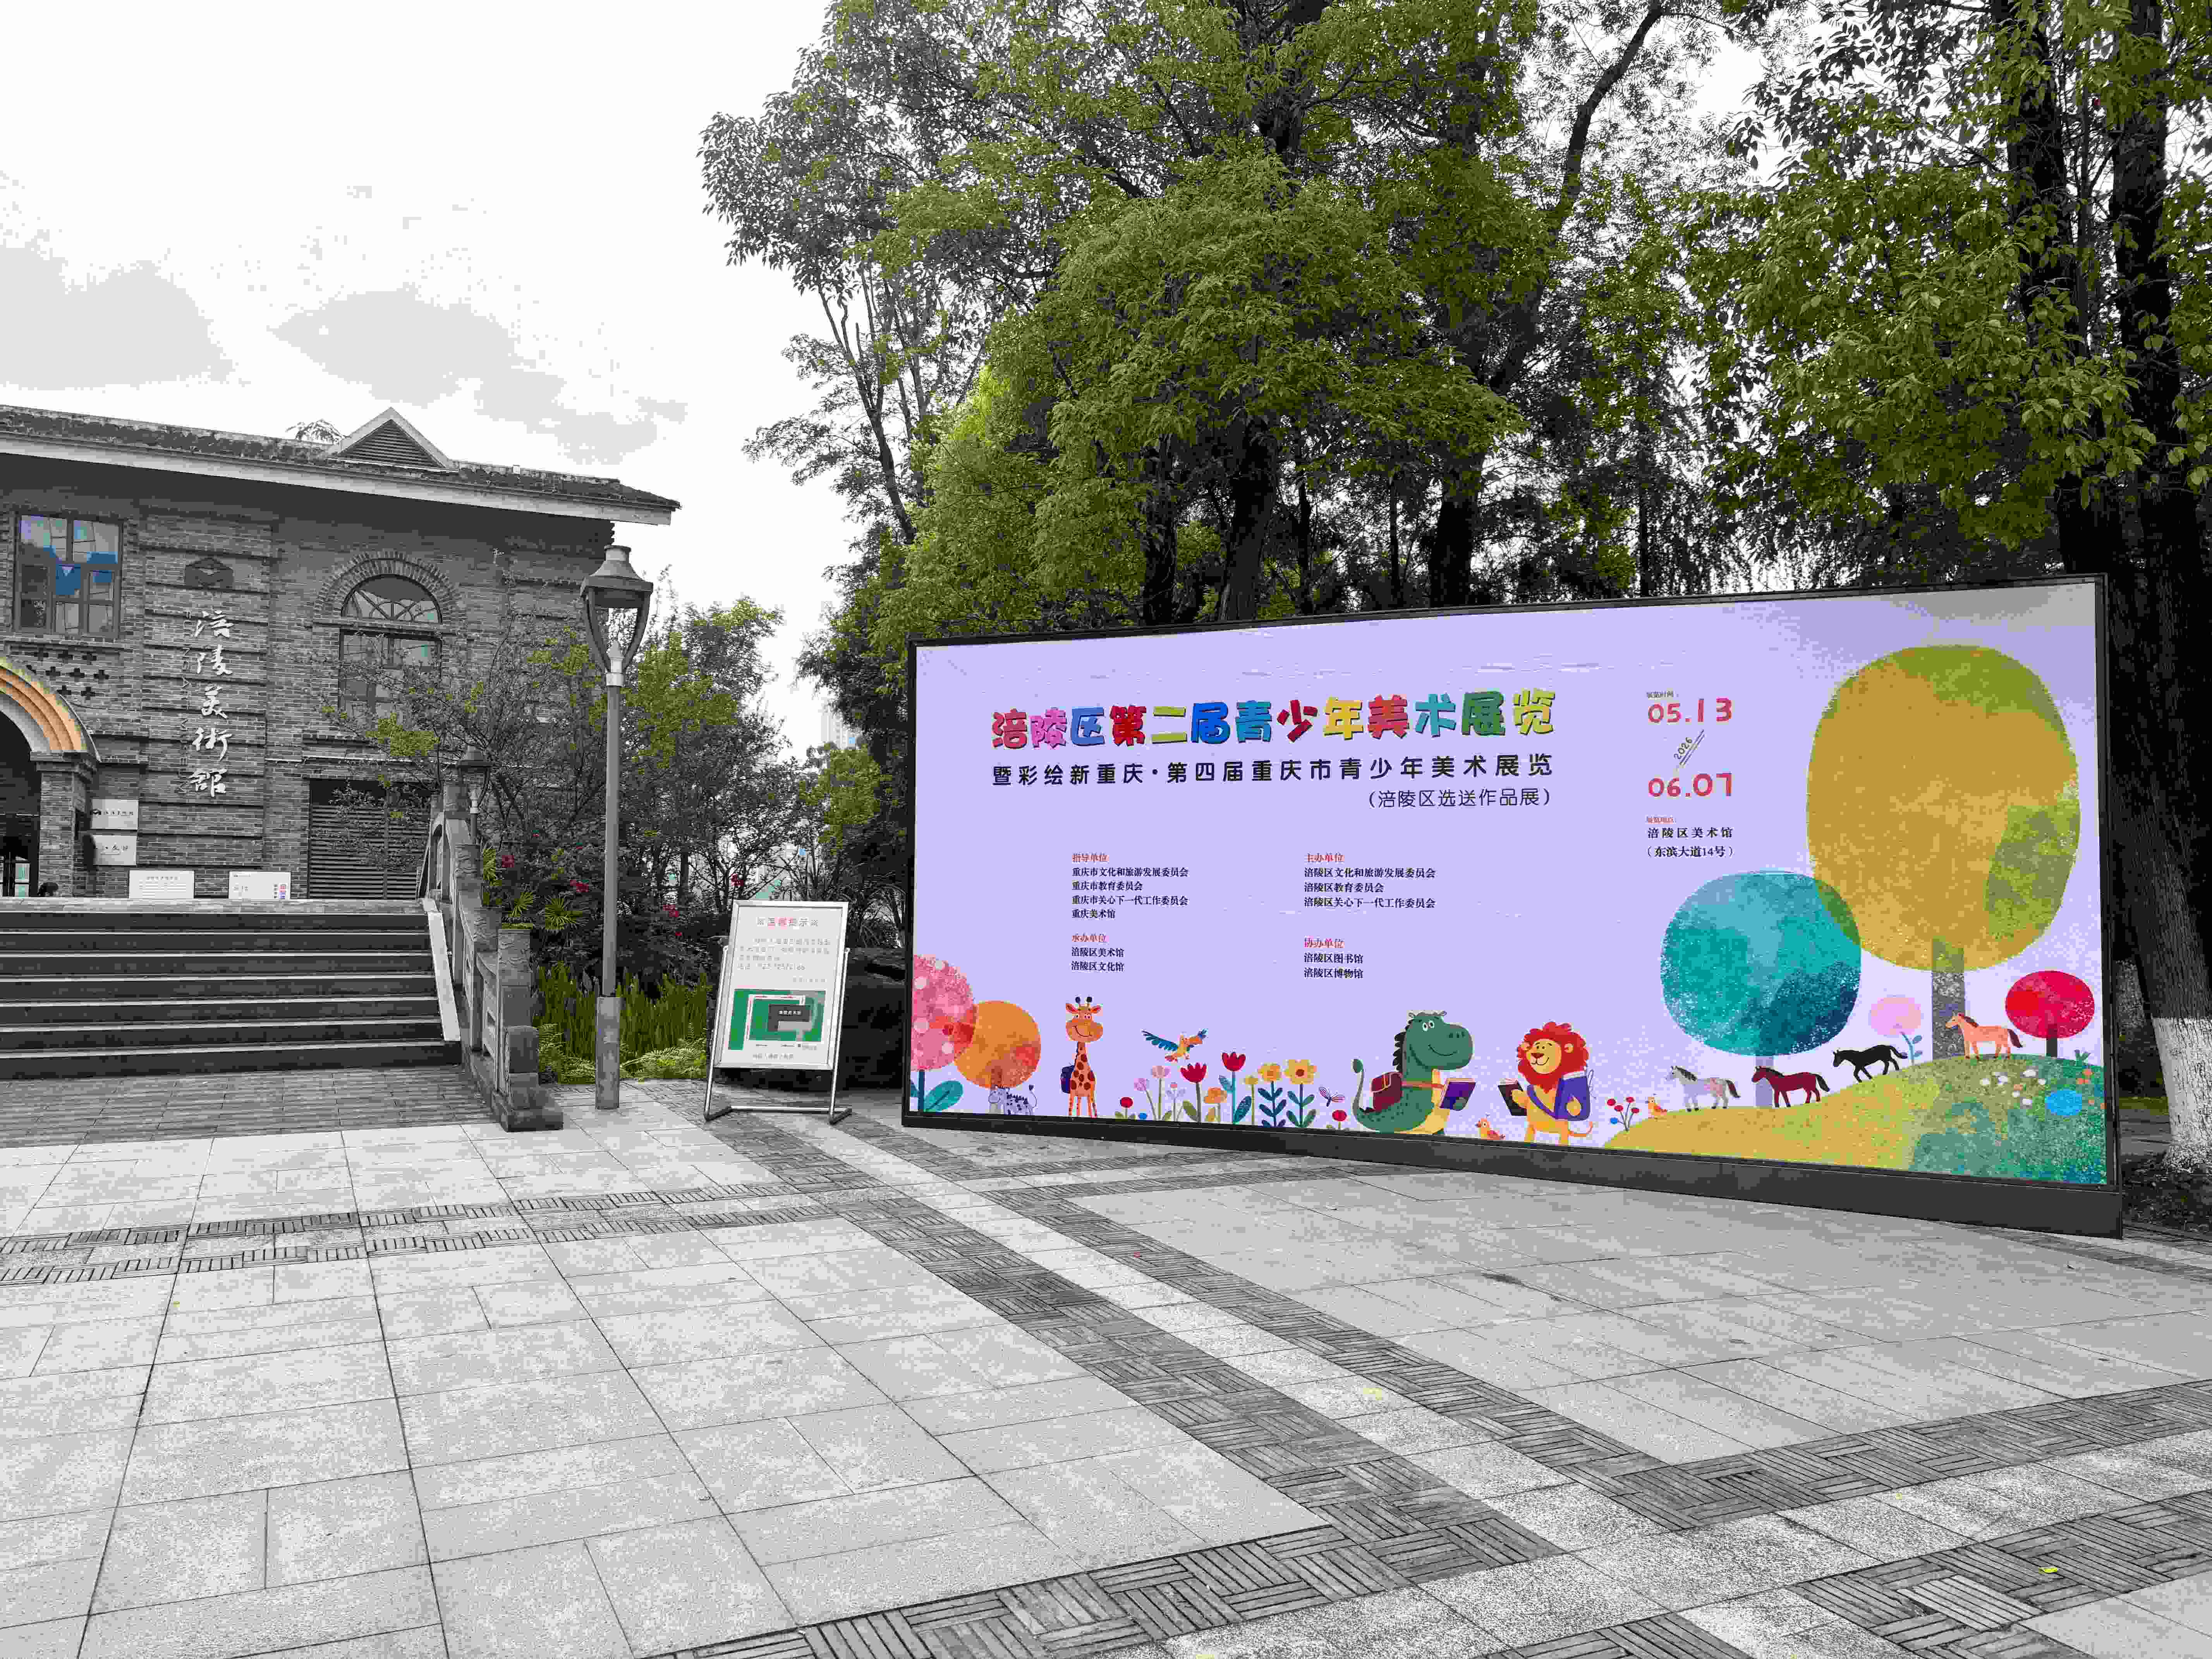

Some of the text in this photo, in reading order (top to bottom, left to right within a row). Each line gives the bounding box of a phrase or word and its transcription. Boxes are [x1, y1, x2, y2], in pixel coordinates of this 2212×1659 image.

[1648, 697, 1732, 723] 05.13
[992, 688, 1555, 749] 涪陵区第二届青少年美术展览
[1648, 773, 1732, 797] 06.07
[1648, 827, 1733, 838] 涪陵区美术馆
[1072, 867, 1188, 877] 重庆市文化和旅游发展委员会
[1305, 867, 1435, 878] 涪陵区文化和旅游发展委员会
[1072, 880, 1142, 890] 重庆市教育委员会
[1304, 882, 1383, 892] 涪陵区教育委员会
[1072, 895, 1188, 905] 重庆市关心下一代工作委员会
[1304, 897, 1436, 908] 涪陵区关心下一代工作委员会
[1072, 909, 1115, 918] 重庆美术馆
[1072, 947, 1124, 957] 涪陵区美术馆
[1304, 953, 1363, 963] 涪陵区图书馆
[1072, 961, 1124, 971] 涪陵区文化馆
[1304, 968, 1363, 978] 涪陵区博物馆
